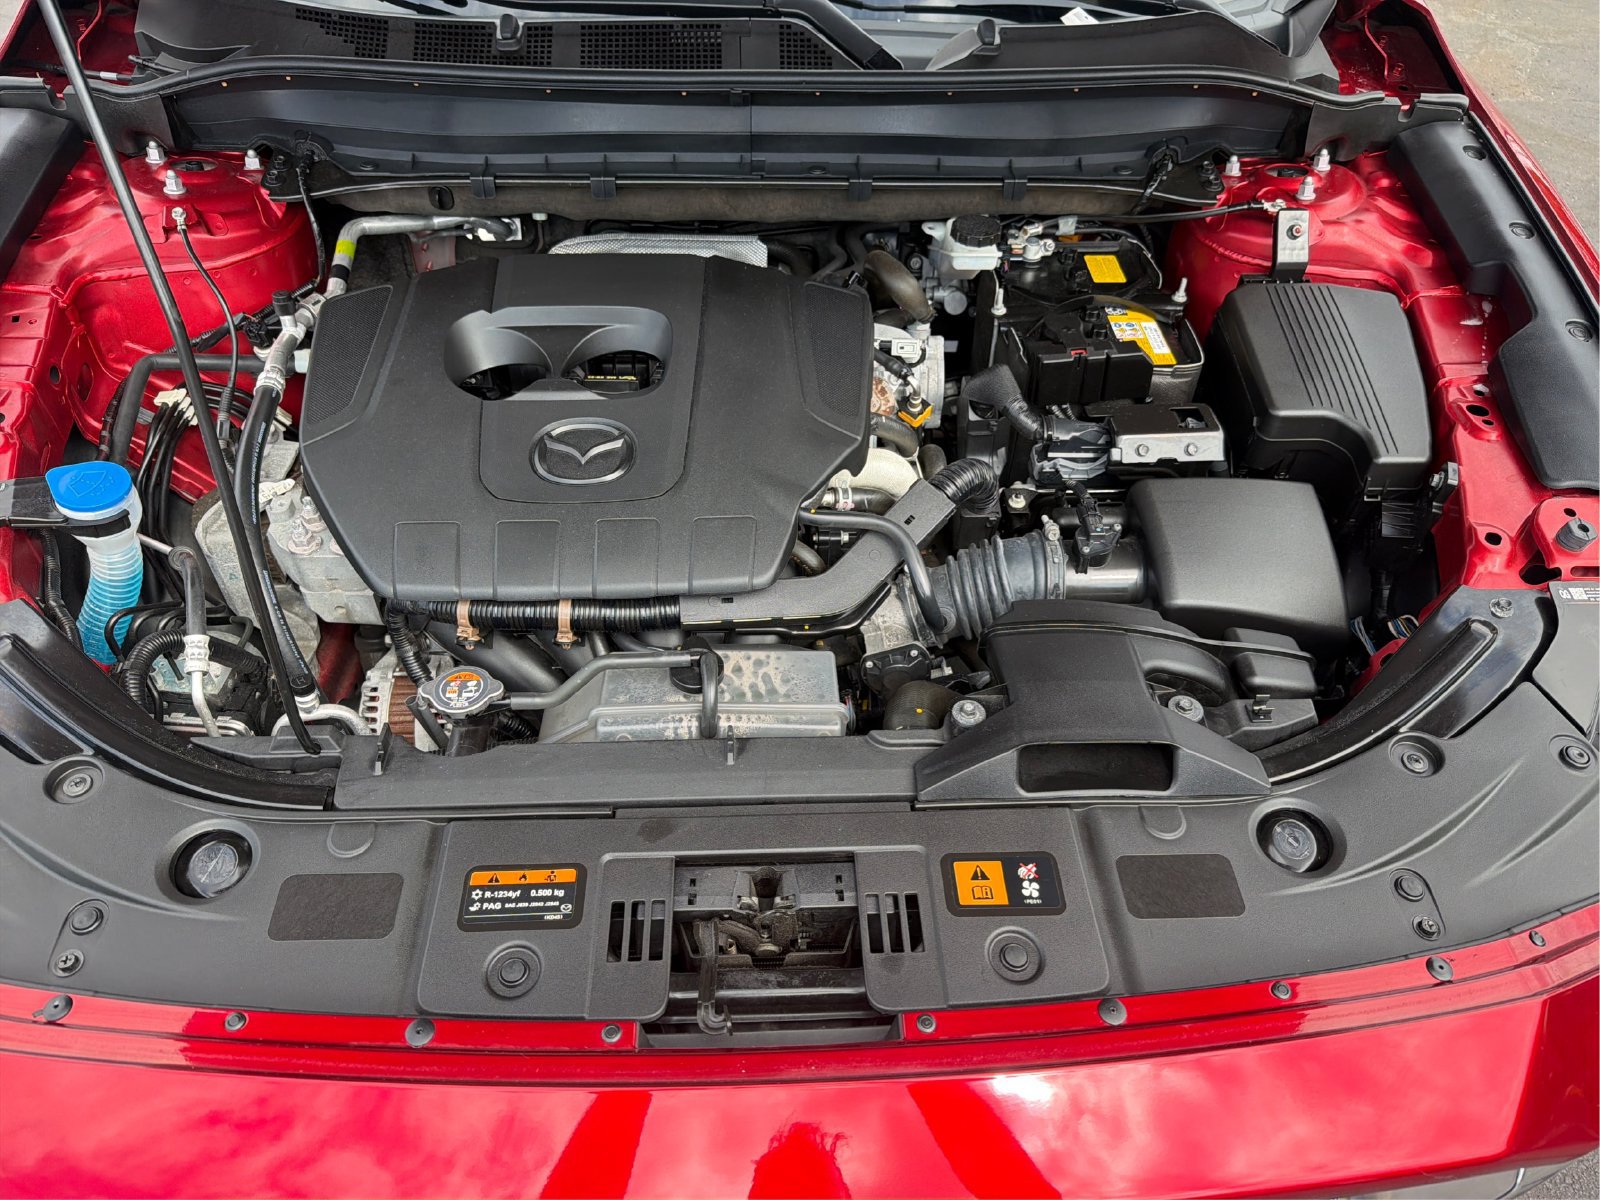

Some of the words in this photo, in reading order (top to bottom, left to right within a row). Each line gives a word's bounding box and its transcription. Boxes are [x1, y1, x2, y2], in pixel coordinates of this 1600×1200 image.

[484, 889, 521, 899] R-1234yf
[530, 889, 552, 897] 0.500
[554, 889, 565, 897] kg
[482, 902, 502, 910] PAG
